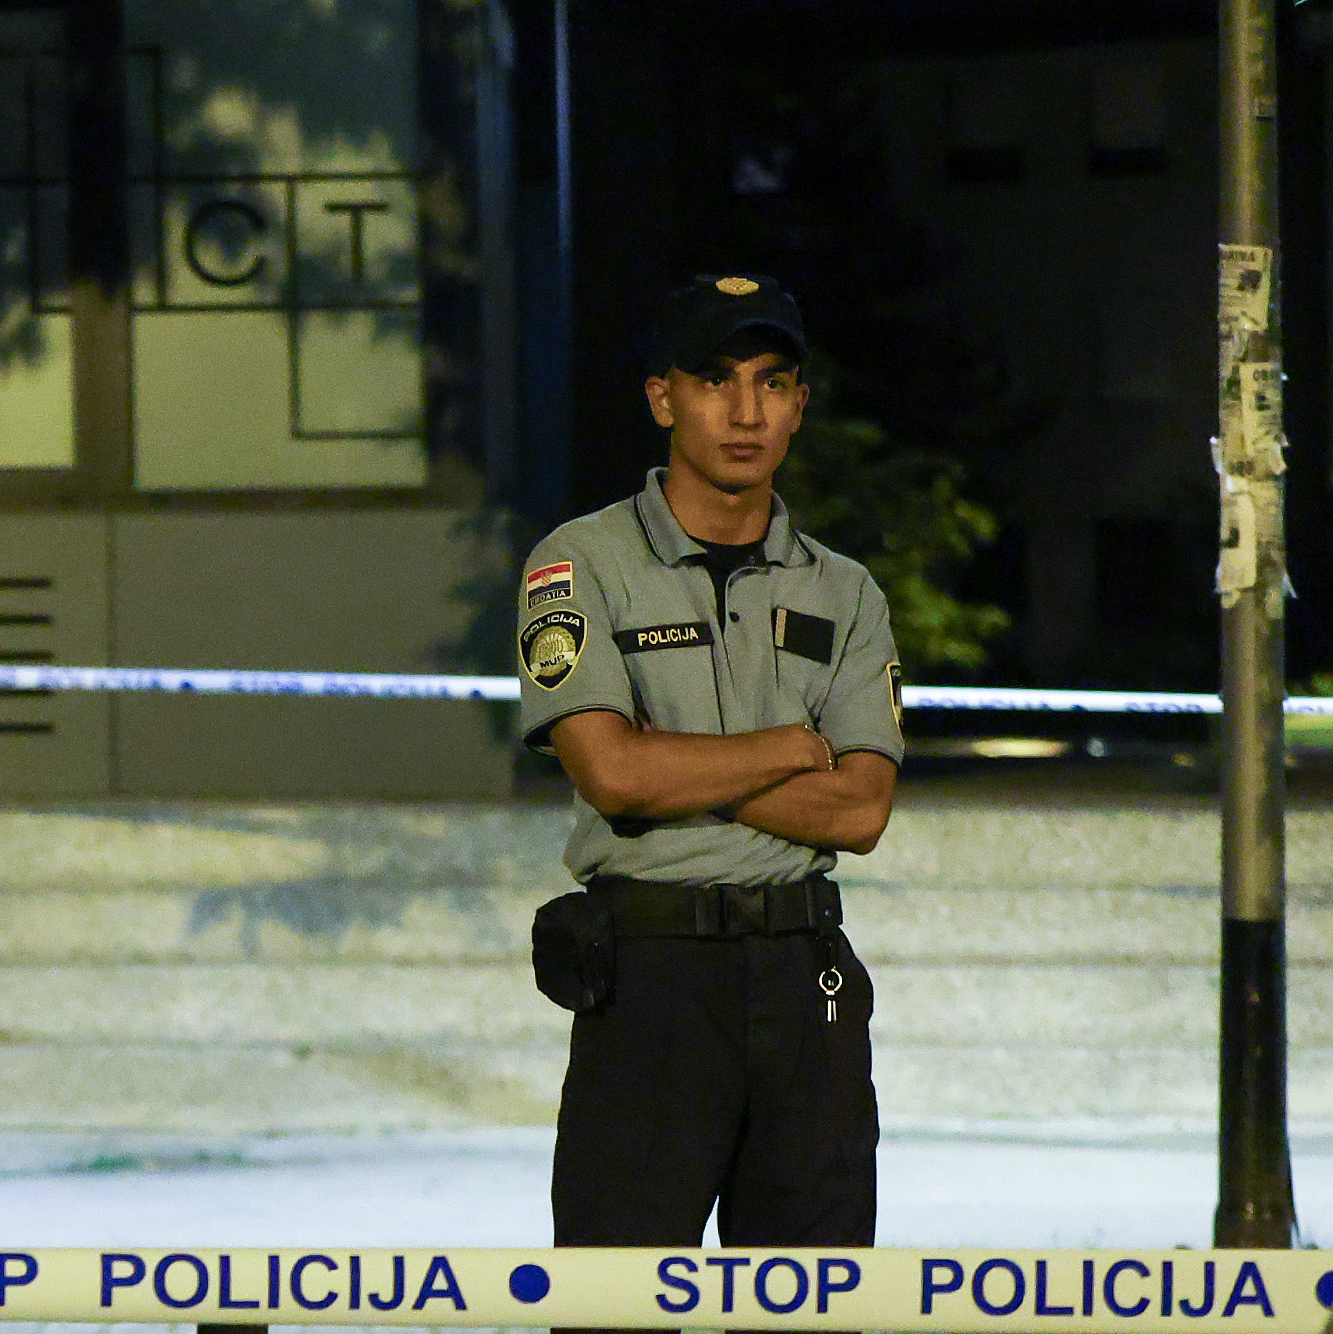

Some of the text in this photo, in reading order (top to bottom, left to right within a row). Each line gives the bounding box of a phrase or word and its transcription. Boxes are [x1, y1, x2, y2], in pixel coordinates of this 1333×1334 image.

[637, 626, 699, 647] POLICIJA
[539, 653, 565, 669] MUP
[101, 1253, 467, 1312] POLICIJA
[656, 1256, 862, 1314] STOP
[922, 1258, 1276, 1319] POLICIJA
